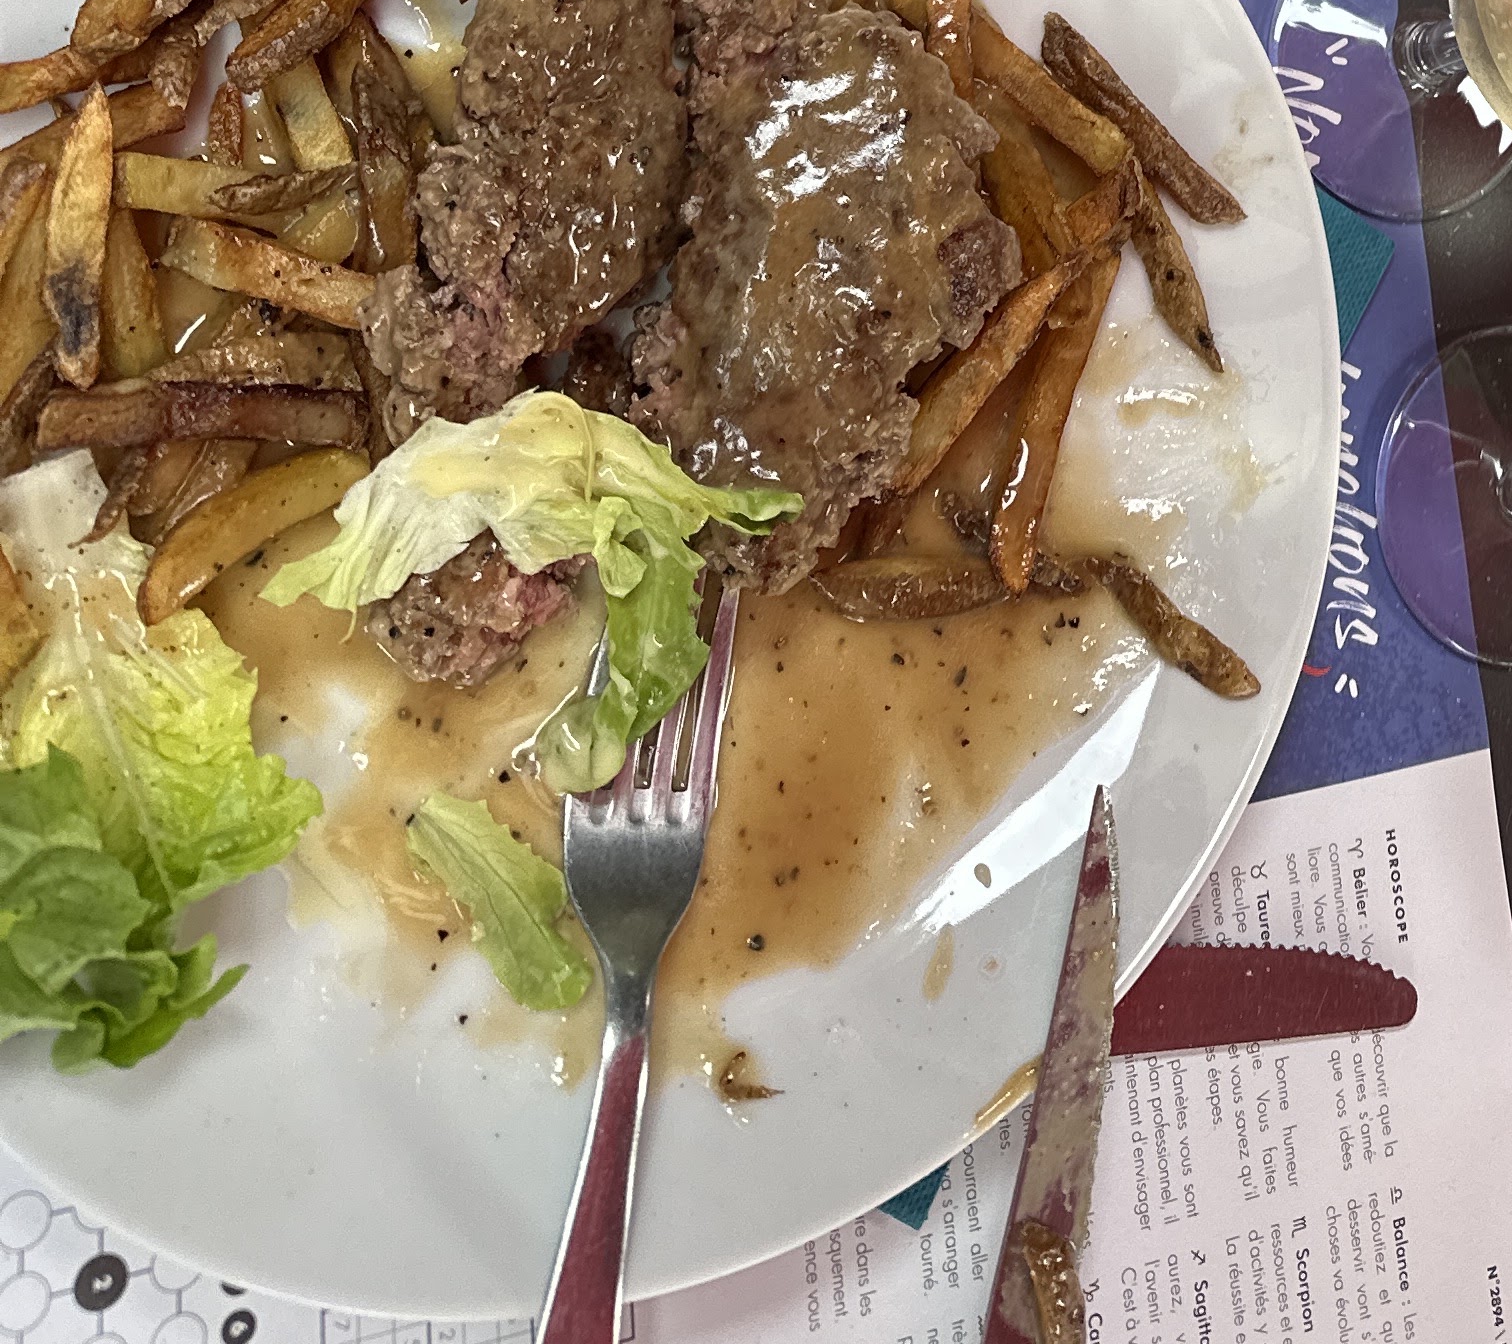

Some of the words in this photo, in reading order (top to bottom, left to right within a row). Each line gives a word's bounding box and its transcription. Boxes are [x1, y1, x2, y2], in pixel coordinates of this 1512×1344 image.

[1285, 852, 1298, 885] sont
[1353, 867, 1369, 918] Bélier
[1388, 828, 1406, 944] HOROSCOPE
[1290, 890, 1304, 938] mieux
[1312, 894, 1329, 934] Vous
[1330, 841, 1349, 959] communicatio
[1359, 933, 1376, 966] Vou
[1145, 1055, 1164, 1093] plan
[1170, 1057, 1191, 1131] planètes
[1229, 1064, 1243, 1104] vous
[1274, 1056, 1293, 1111] bonne
[1352, 1052, 1367, 1102] autres
[1255, 1089, 1273, 1133] Vous
[1334, 1088, 1346, 1118] vos
[1378, 1103, 1391, 1136] que
[1178, 1135, 1193, 1176] vous
[1234, 1109, 1249, 1159] savez
[1282, 1124, 1302, 1188] humeur
[1339, 1124, 1355, 1172] idées
[1383, 1139, 1398, 1158] la
[961, 1143, 980, 1234] pourraient
[1262, 1145, 1281, 1195] faites
[1183, 1182, 1198, 1218] sont
[938, 1197, 964, 1291] s'arranger
[1347, 1198, 1367, 1274] desservir
[854, 1240, 875, 1287] dans
[969, 1241, 988, 1282] aller
[1248, 1228, 1270, 1316] d'activités
[1270, 1222, 1288, 1312] ressources
[1393, 1216, 1411, 1292] Balance
[1403, 1312, 1418, 1341] Les
[858, 1289, 878, 1318] les
[1294, 1247, 1316, 1333] Scorpion
[1356, 1283, 1370, 1320] vont
[1488, 1265, 1503, 1327] N°2894
